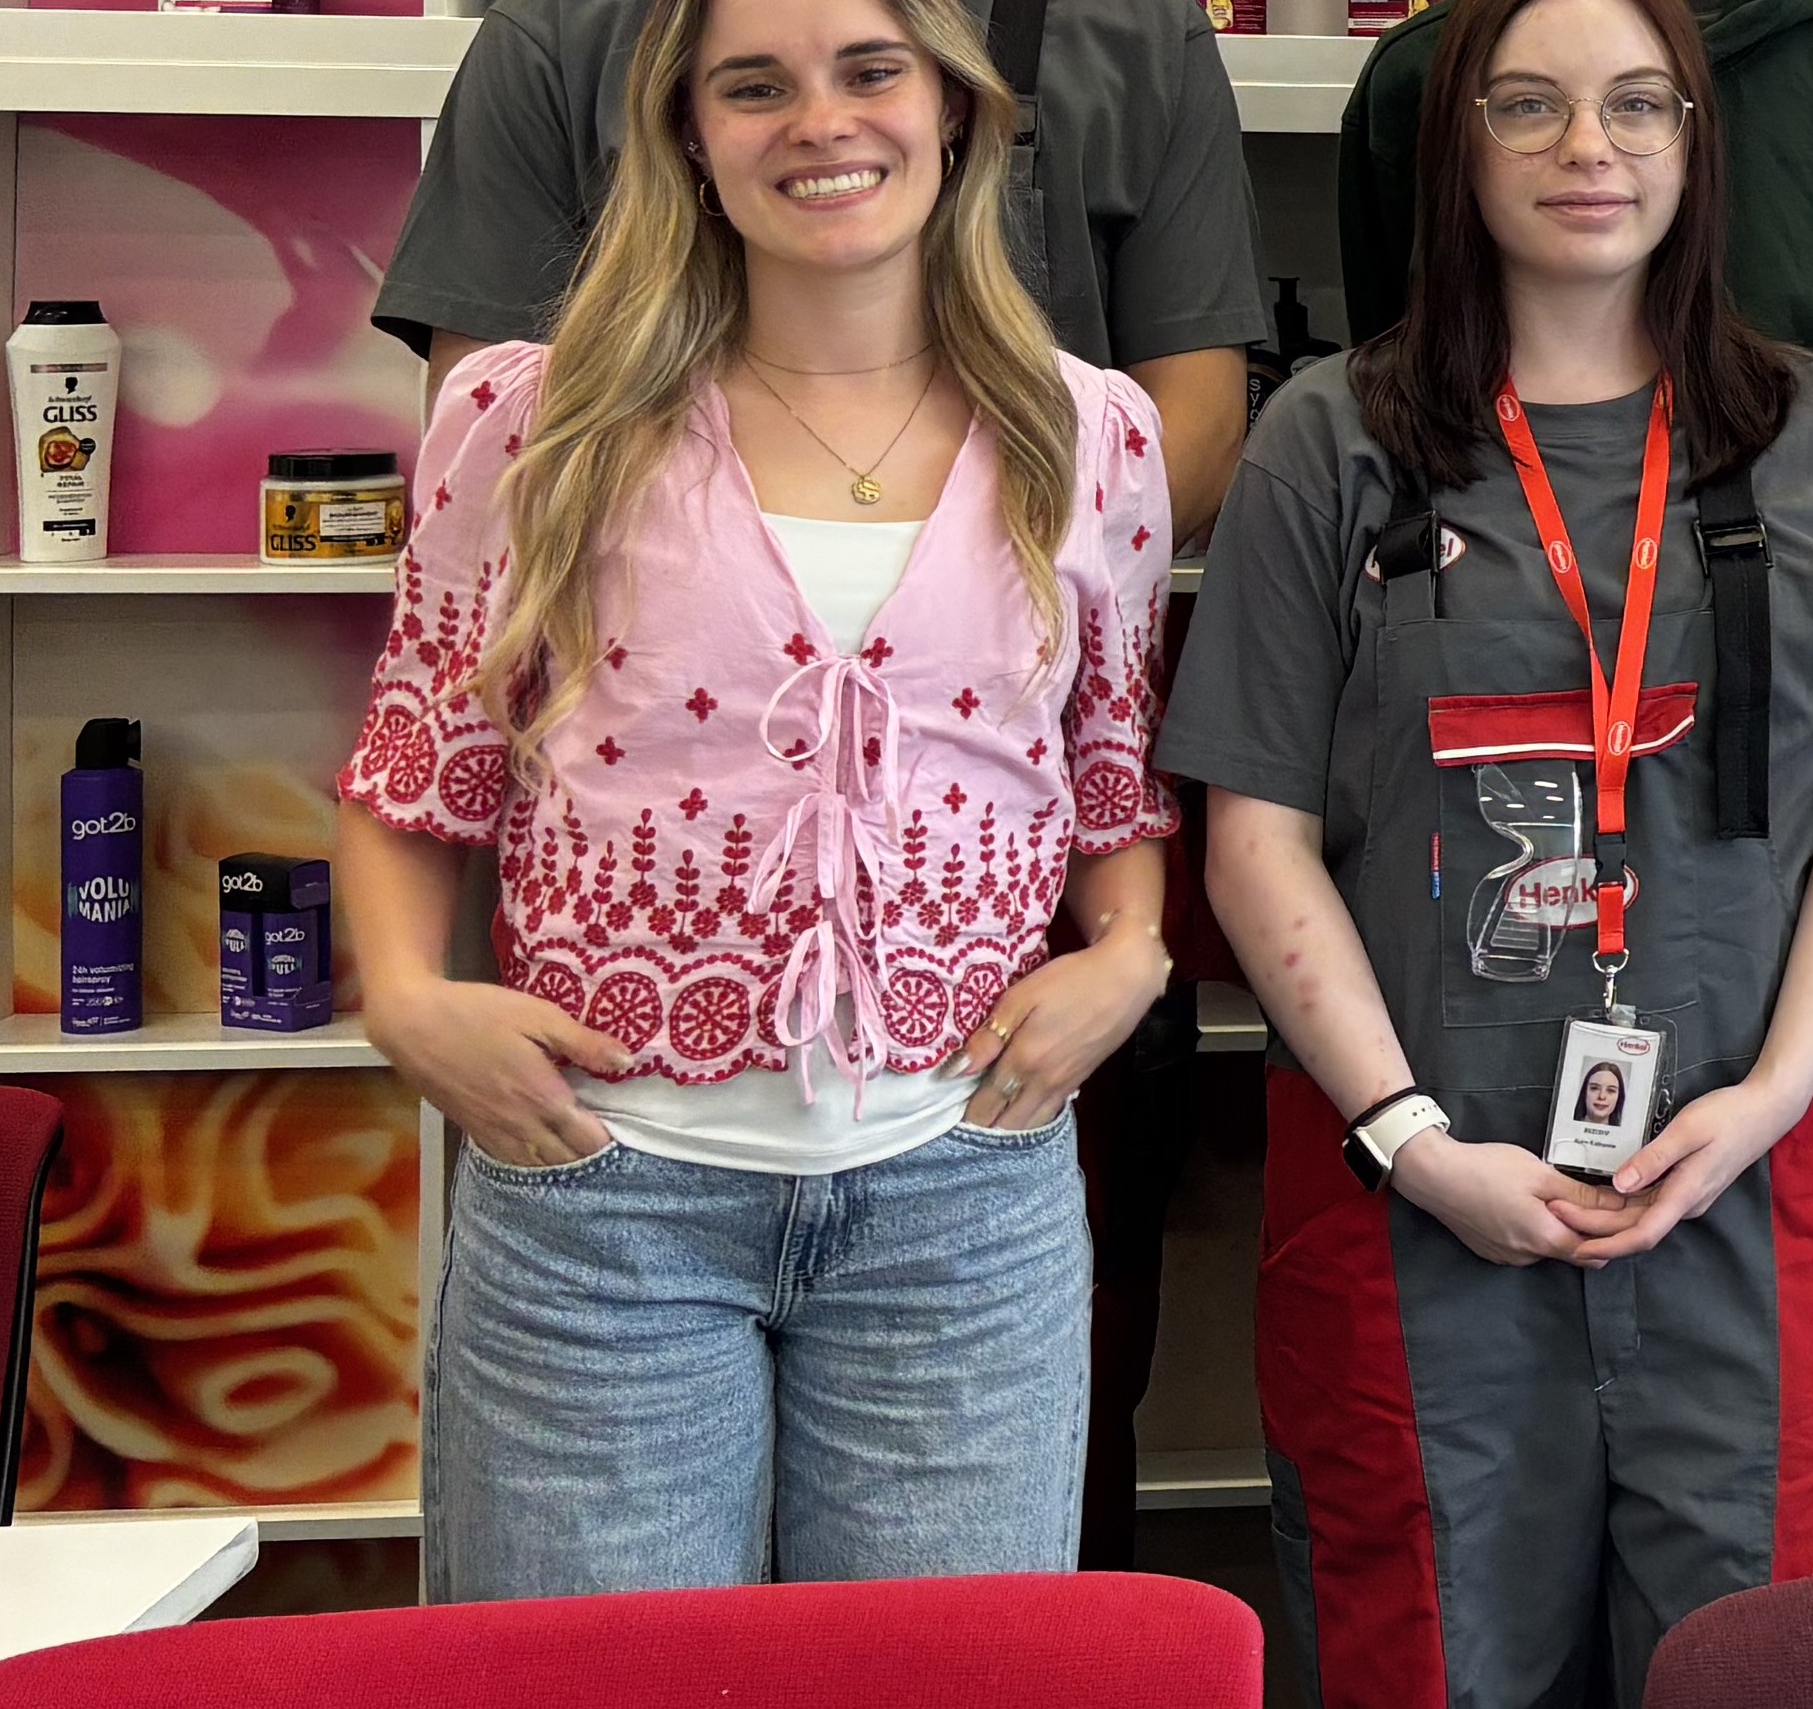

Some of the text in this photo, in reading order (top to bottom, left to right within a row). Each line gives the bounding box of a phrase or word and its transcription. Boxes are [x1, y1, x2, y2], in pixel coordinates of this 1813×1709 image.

[43, 404, 98, 423] GLISS
[270, 534, 317, 552] GLISS
[72, 812, 136, 840] got2b
[79, 876, 129, 900] VOLU
[222, 872, 263, 893] got2b
[1519, 878, 1598, 908] Henk
[79, 900, 131, 923] MANIA
[265, 927, 305, 945] got2b
